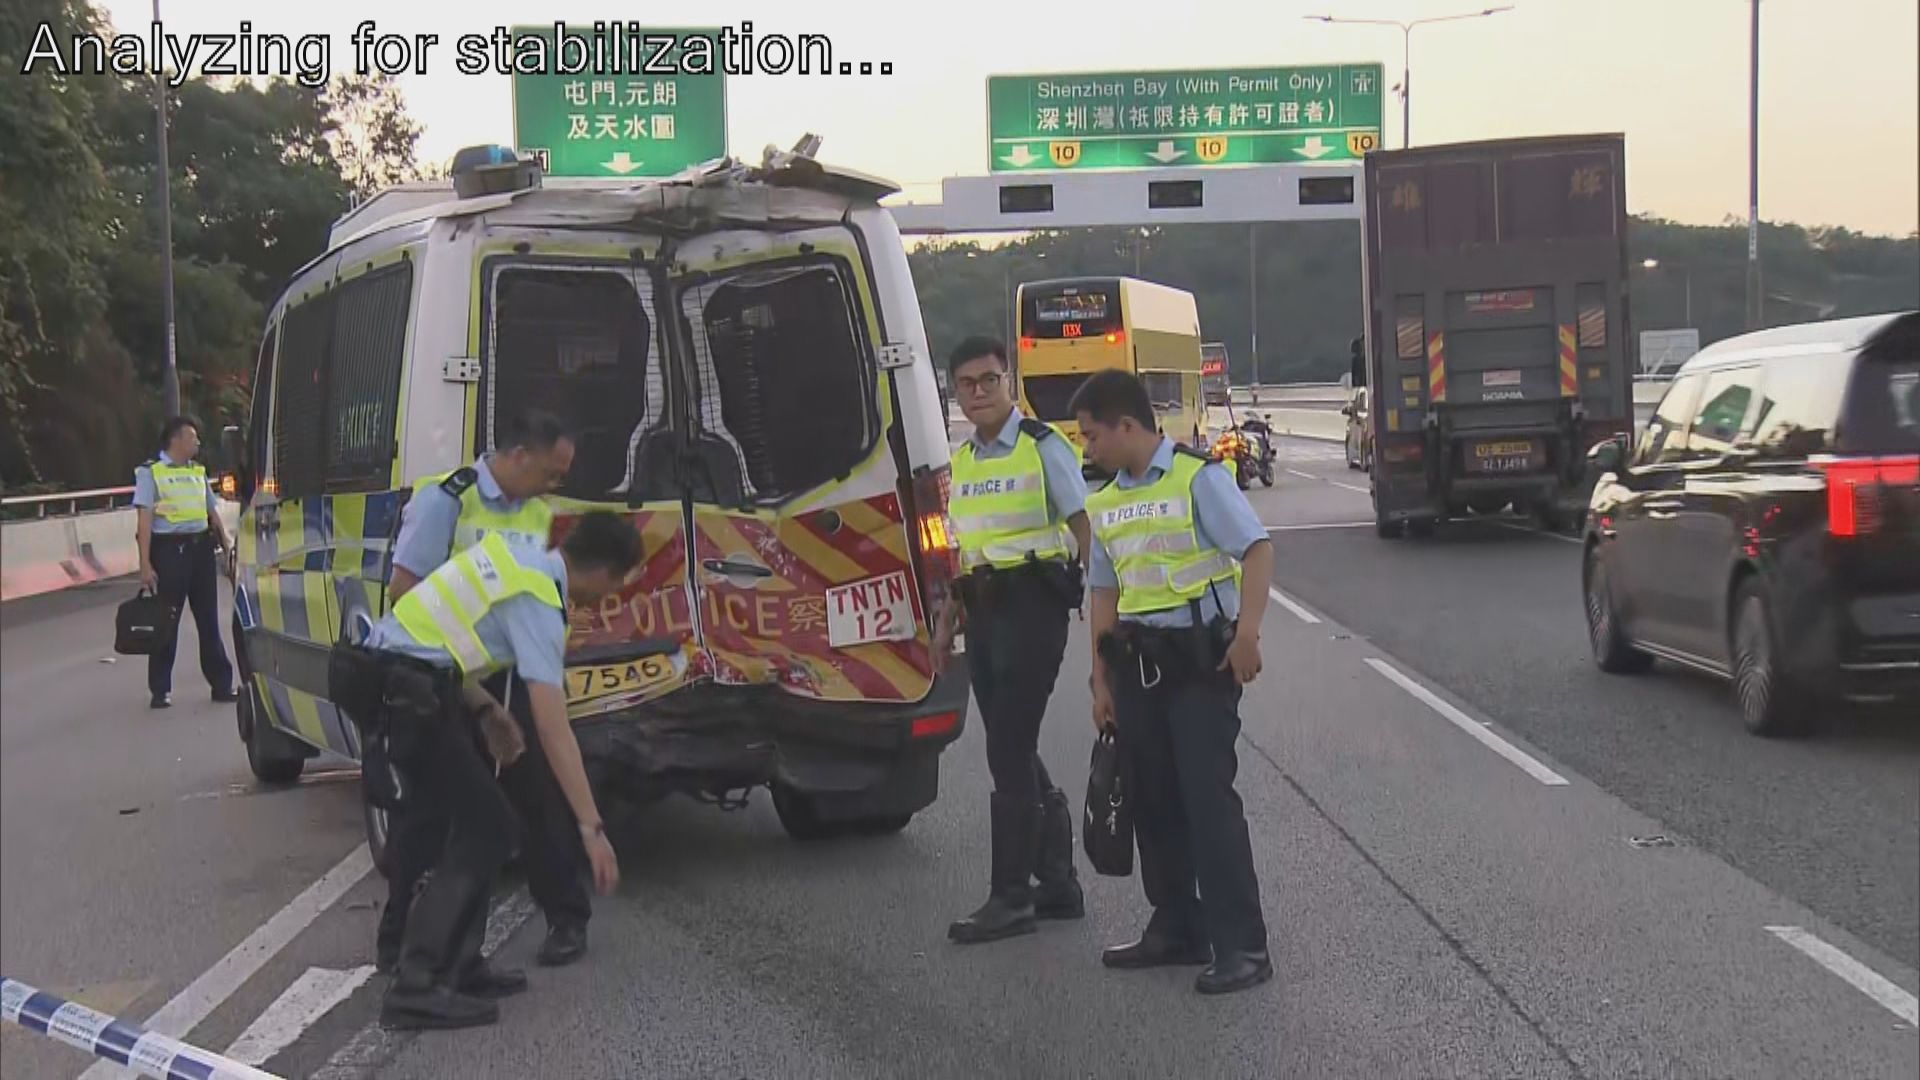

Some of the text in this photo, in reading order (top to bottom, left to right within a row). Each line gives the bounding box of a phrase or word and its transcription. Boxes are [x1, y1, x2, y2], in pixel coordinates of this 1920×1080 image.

[1037, 72, 1333, 98] Shenzhen Bay (With Permit Only)
[1054, 145, 1075, 161] 10
[1201, 140, 1222, 156] 10
[1351, 136, 1374, 151] 10
[830, 575, 904, 615] TNTN
[855, 607, 893, 640] 12
